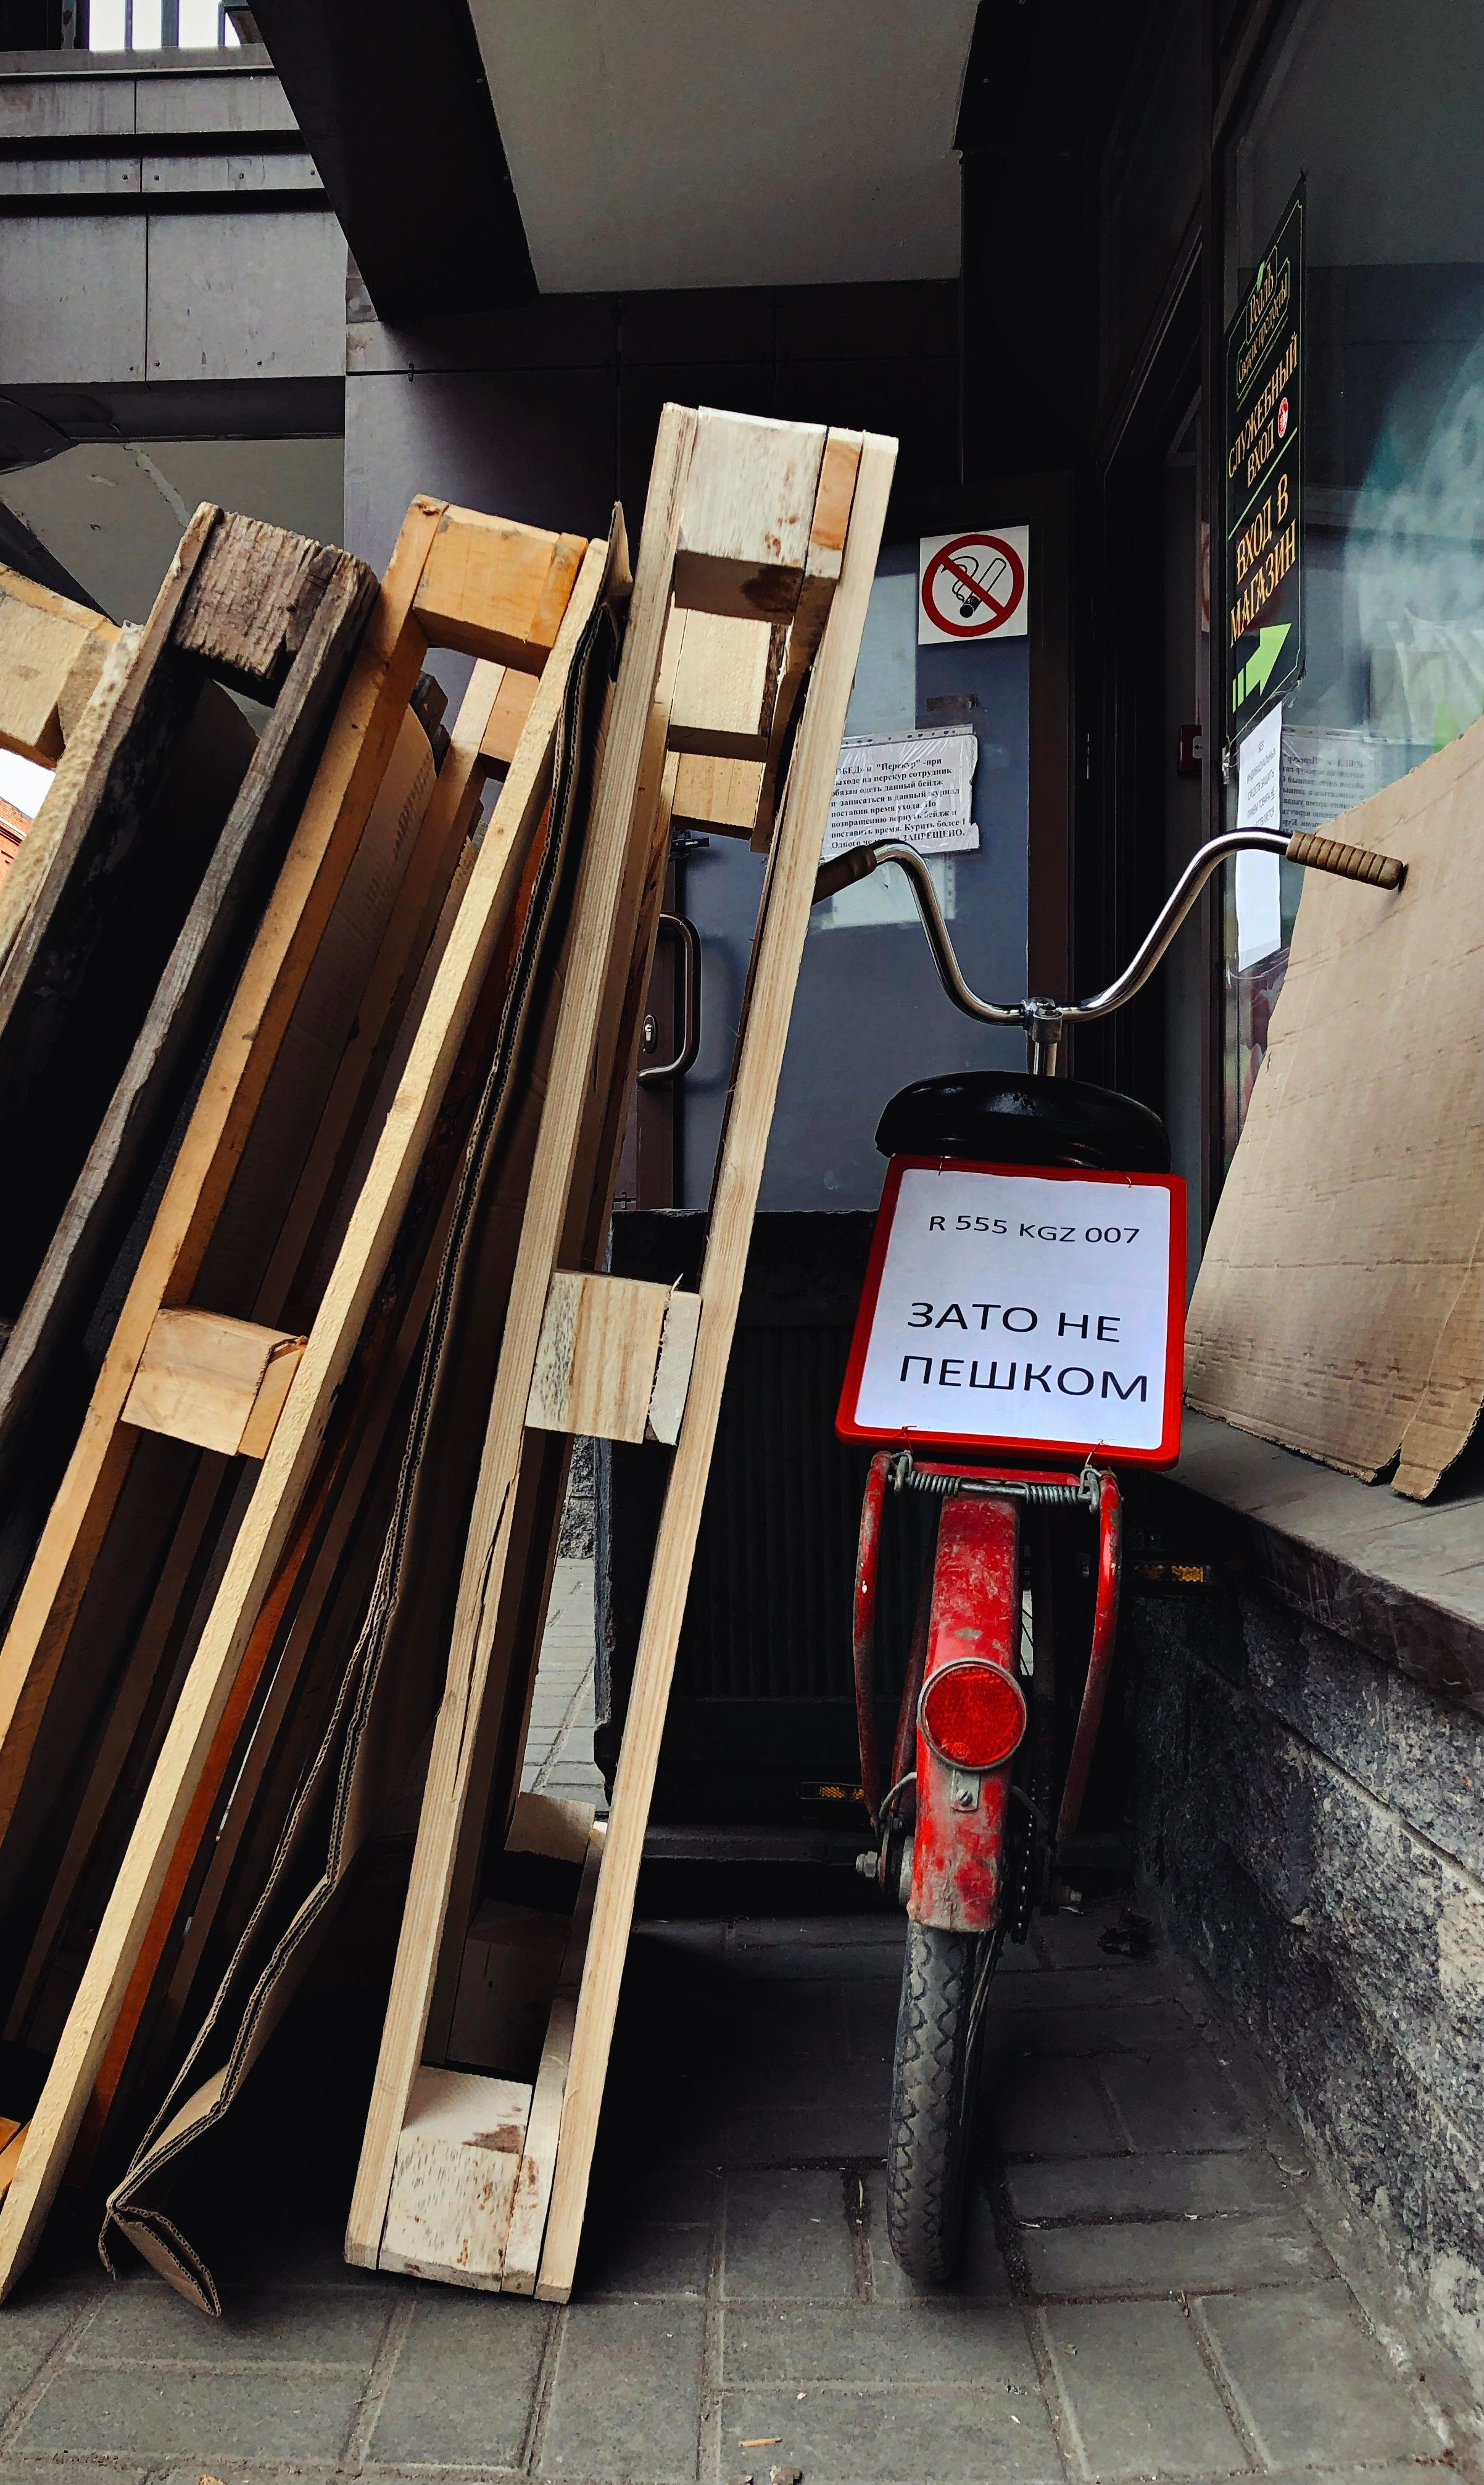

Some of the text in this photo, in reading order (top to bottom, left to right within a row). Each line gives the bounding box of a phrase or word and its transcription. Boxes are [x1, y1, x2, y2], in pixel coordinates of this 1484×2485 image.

[1229, 331, 1298, 478] СЛУЖЕБНЫЙ
[1248, 417, 1274, 488] ВХОД
[1236, 473, 1288, 586] ВХОД В
[1230, 518, 1296, 649] МАГАЗИН
[835, 778, 860, 786] ыходе
[874, 773, 906, 783] перекур
[909, 768, 953, 778] сотрудник
[860, 786, 882, 794] одеть
[884, 781, 916, 792] данный
[918, 779, 943, 788] бейдж
[840, 797, 885, 807] записаться
[894, 790, 926, 802] данный
[831, 808, 868, 818] поставив
[871, 806, 895, 815] время
[831, 818, 887, 828] возвращению
[889, 814, 922, 823] вернуть
[924, 810, 950, 819] бейдж
[831, 830, 873, 839] поставить
[875, 826, 902, 836] время.
[905, 823, 935, 832] Курить
[937, 819, 960, 828] более
[831, 840, 861, 850] Одного
[902, 829, 965, 842] ЗАПРЕЩЕНО.
[929, 1215, 1140, 1244] R 555 KGZ 007
[906, 1302, 1122, 1343] ЗАТО НЕ
[899, 1355, 1148, 1403] ПЕШКОМ
